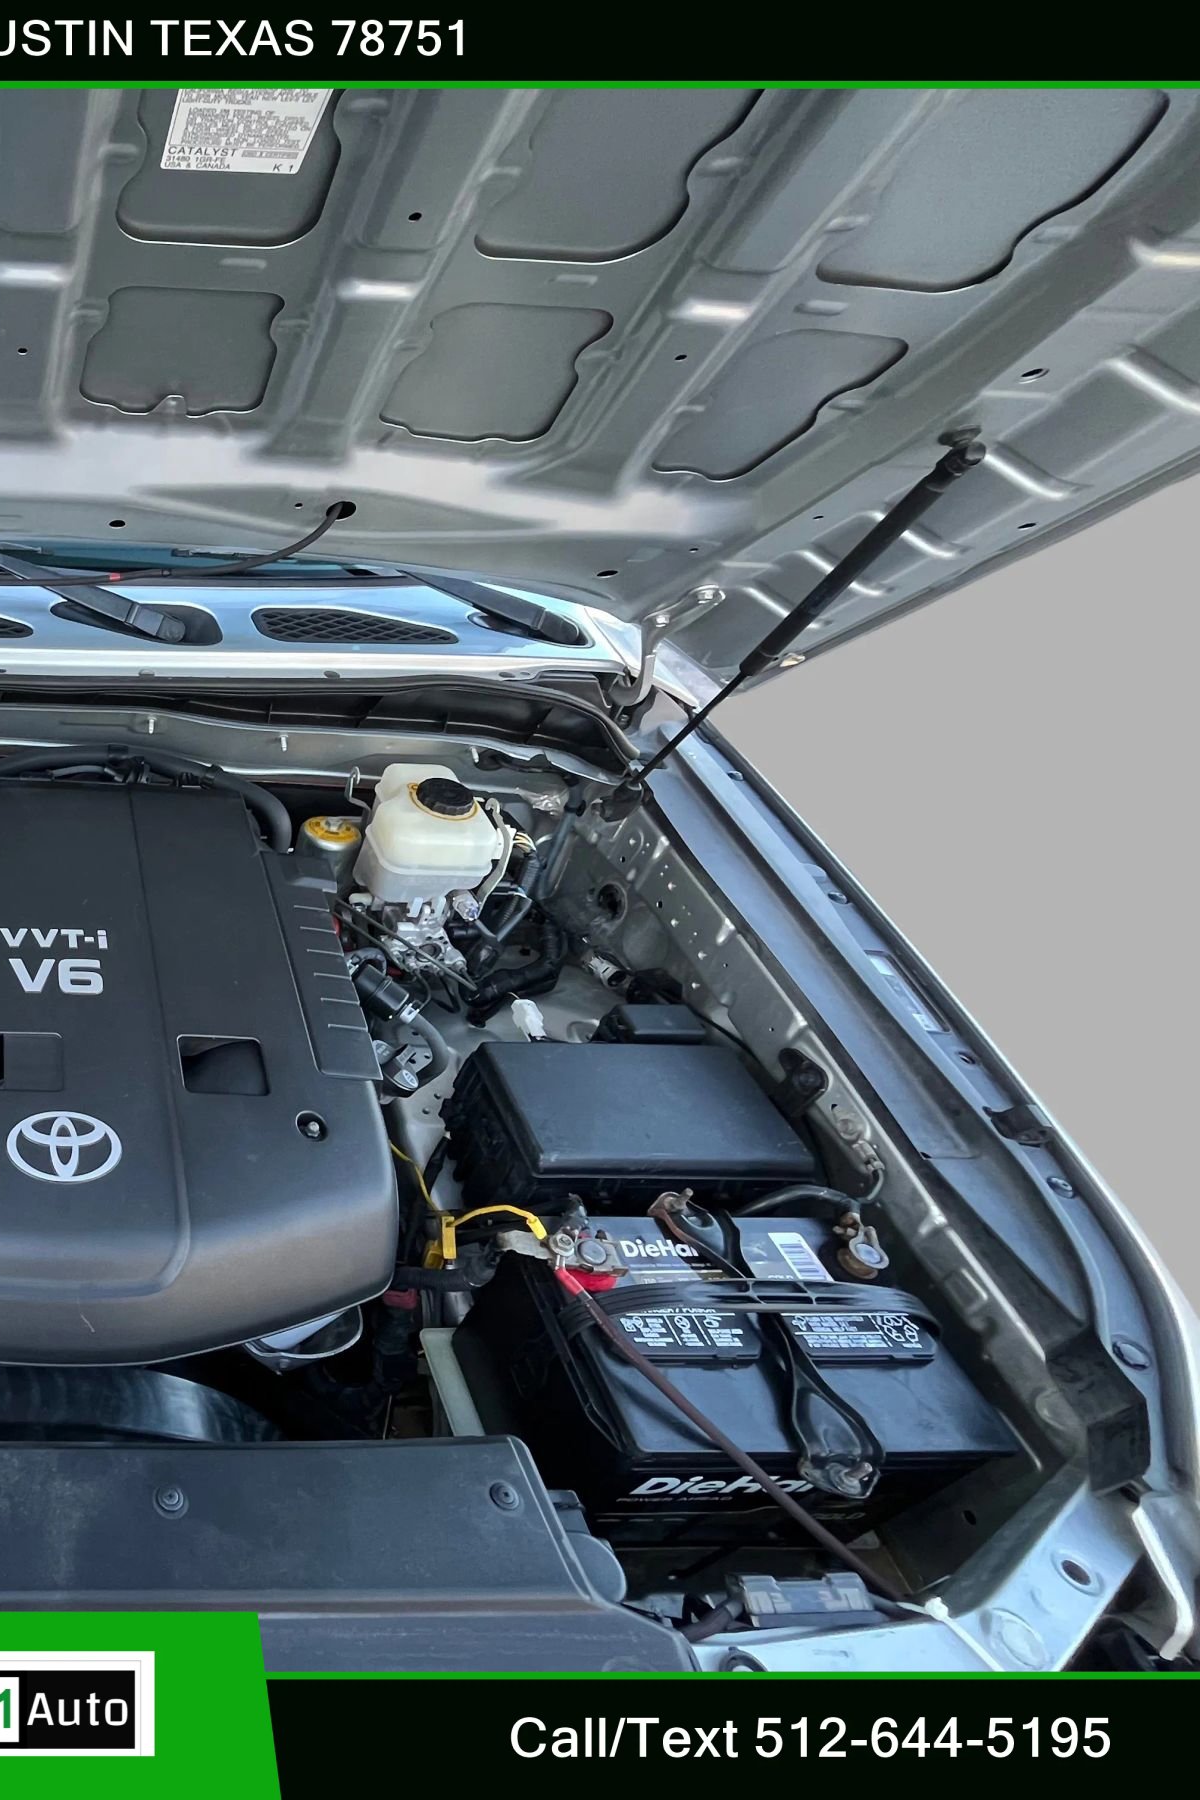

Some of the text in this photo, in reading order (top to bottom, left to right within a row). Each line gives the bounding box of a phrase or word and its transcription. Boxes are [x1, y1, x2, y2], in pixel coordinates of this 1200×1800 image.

[167, 146, 237, 157] CATALYST
[272, 163, 283, 172] K
[0, 927, 108, 949] VVT-i
[8, 958, 104, 995] V6
[619, 1238, 699, 1258] DieHar
[628, 1475, 815, 1495] DieHar
